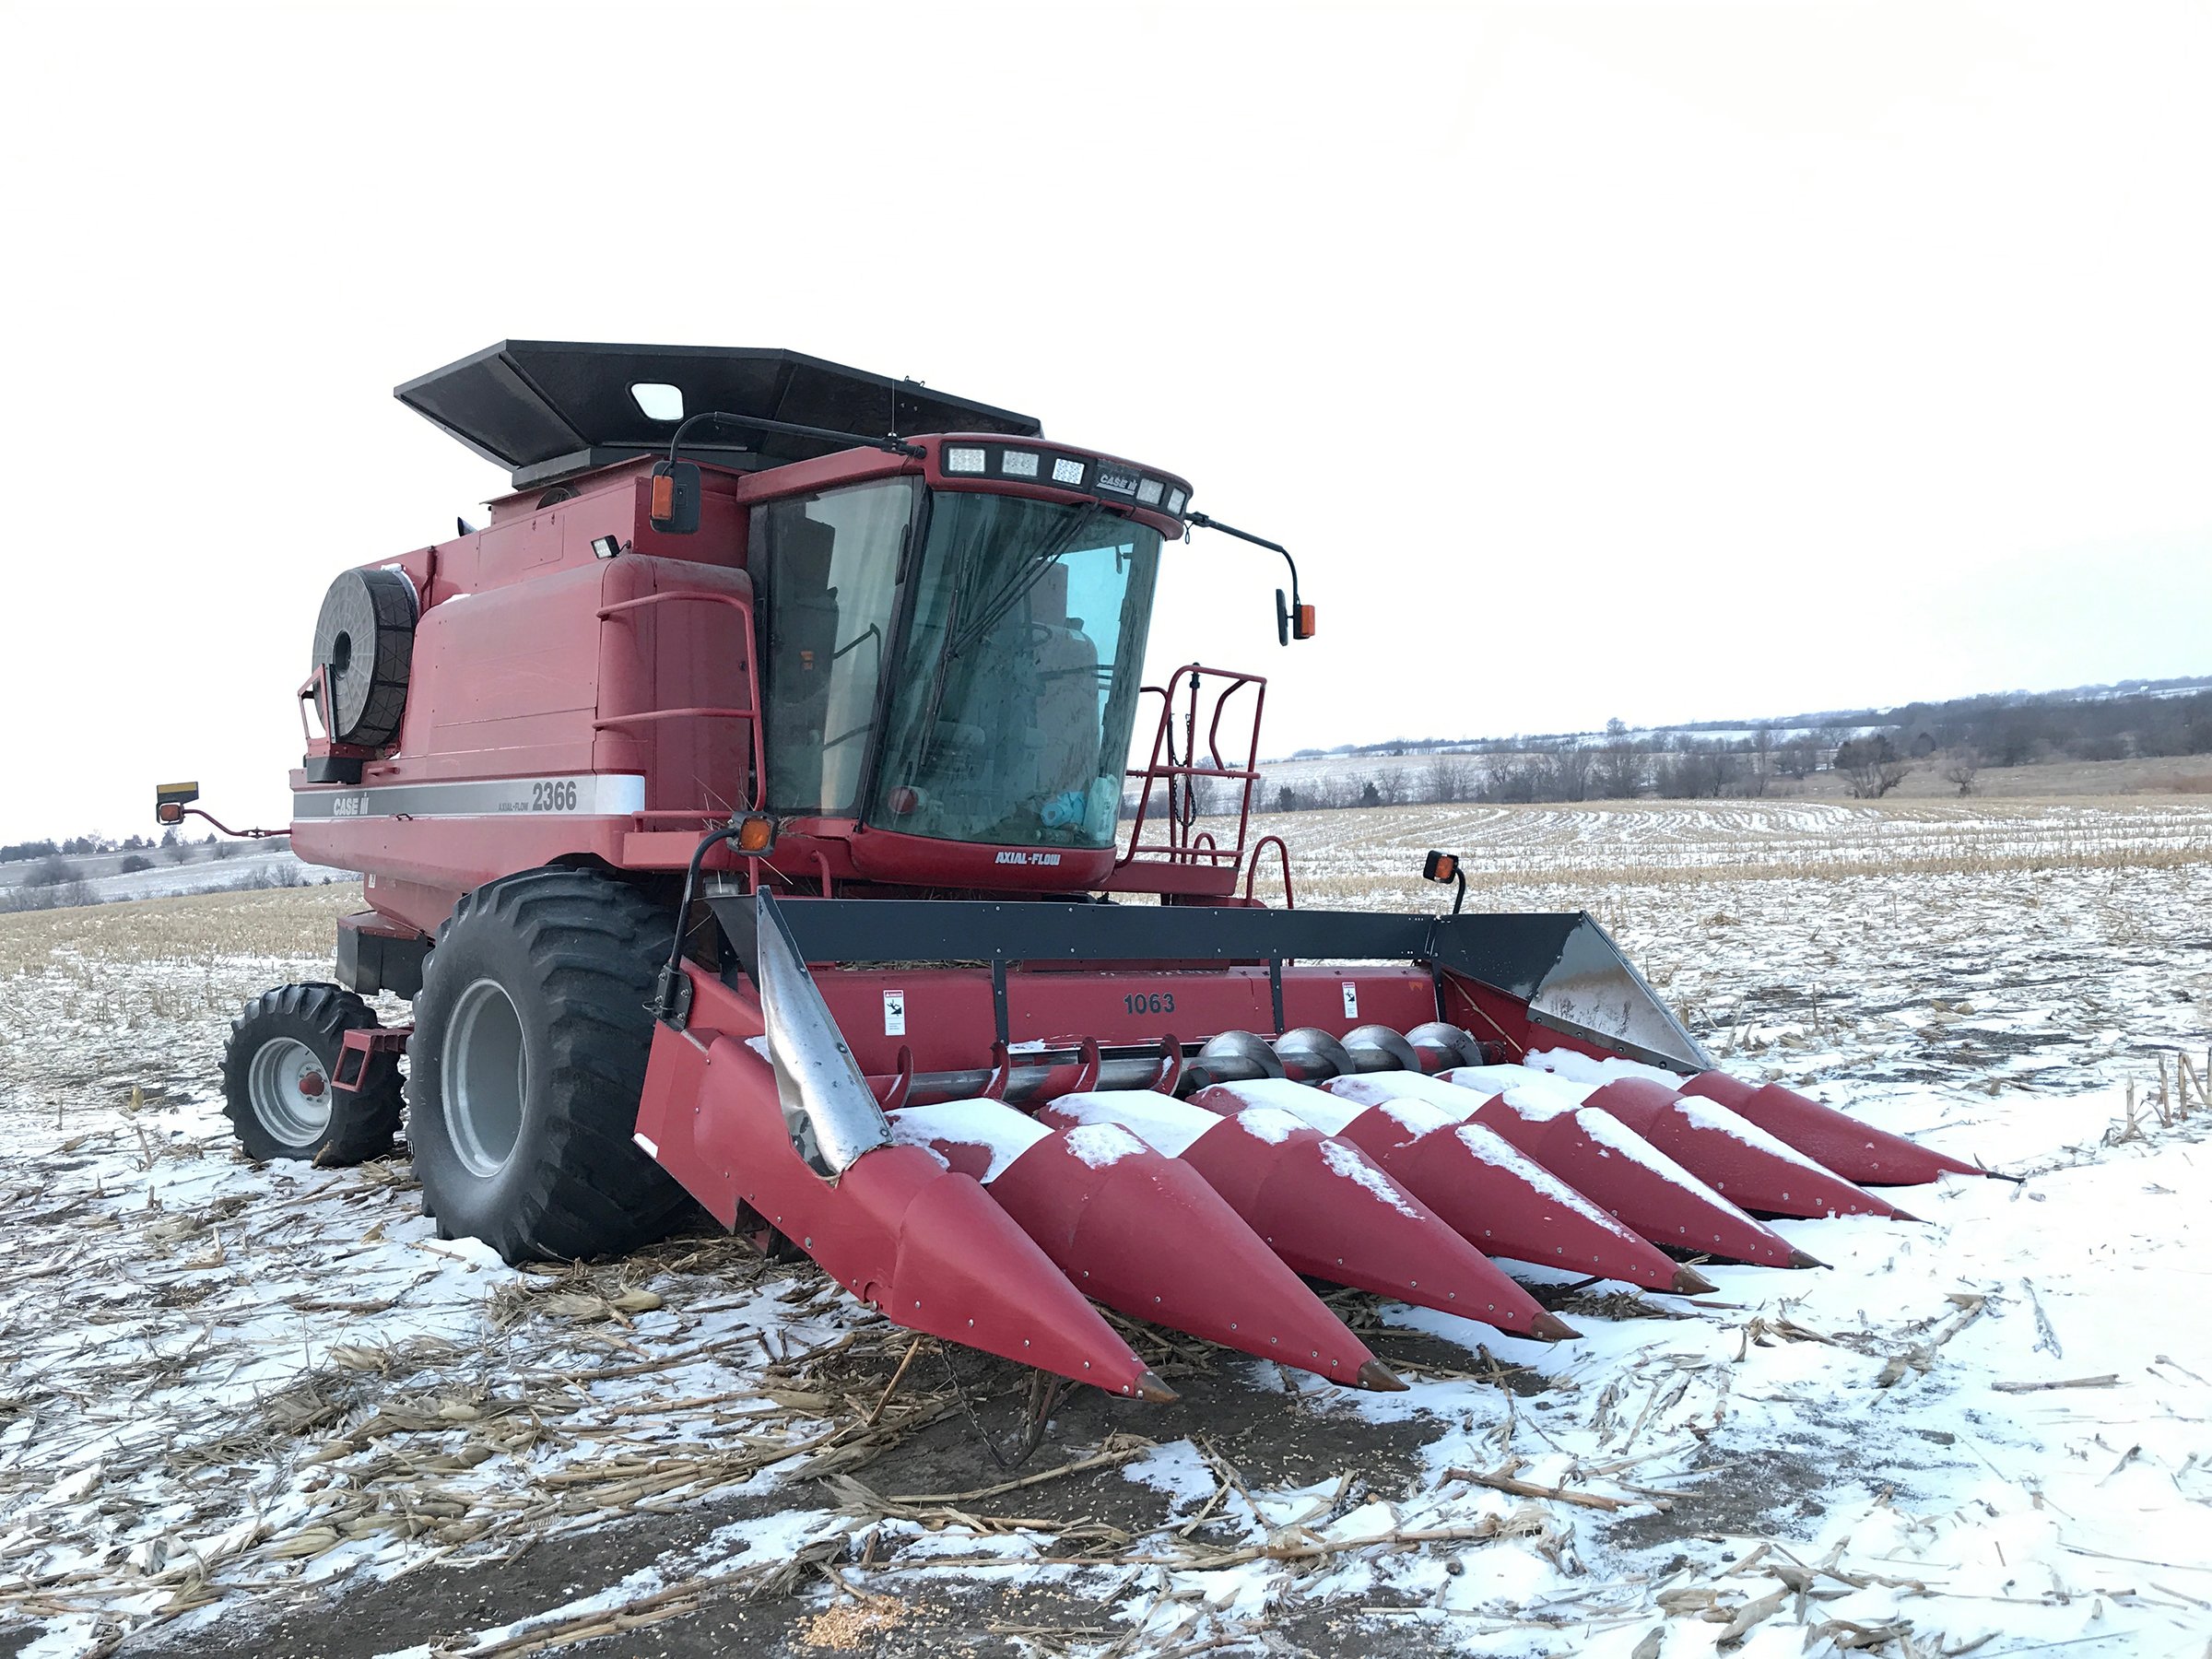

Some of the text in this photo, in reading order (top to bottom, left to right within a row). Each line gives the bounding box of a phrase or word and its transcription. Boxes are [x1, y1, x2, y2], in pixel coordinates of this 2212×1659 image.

[1100, 474, 1128, 488] CASE
[533, 781, 576, 811] 2366
[334, 797, 359, 816] CASE
[995, 852, 1061, 865] AXIAL-FLOW
[1124, 993, 1175, 1014] 1063
